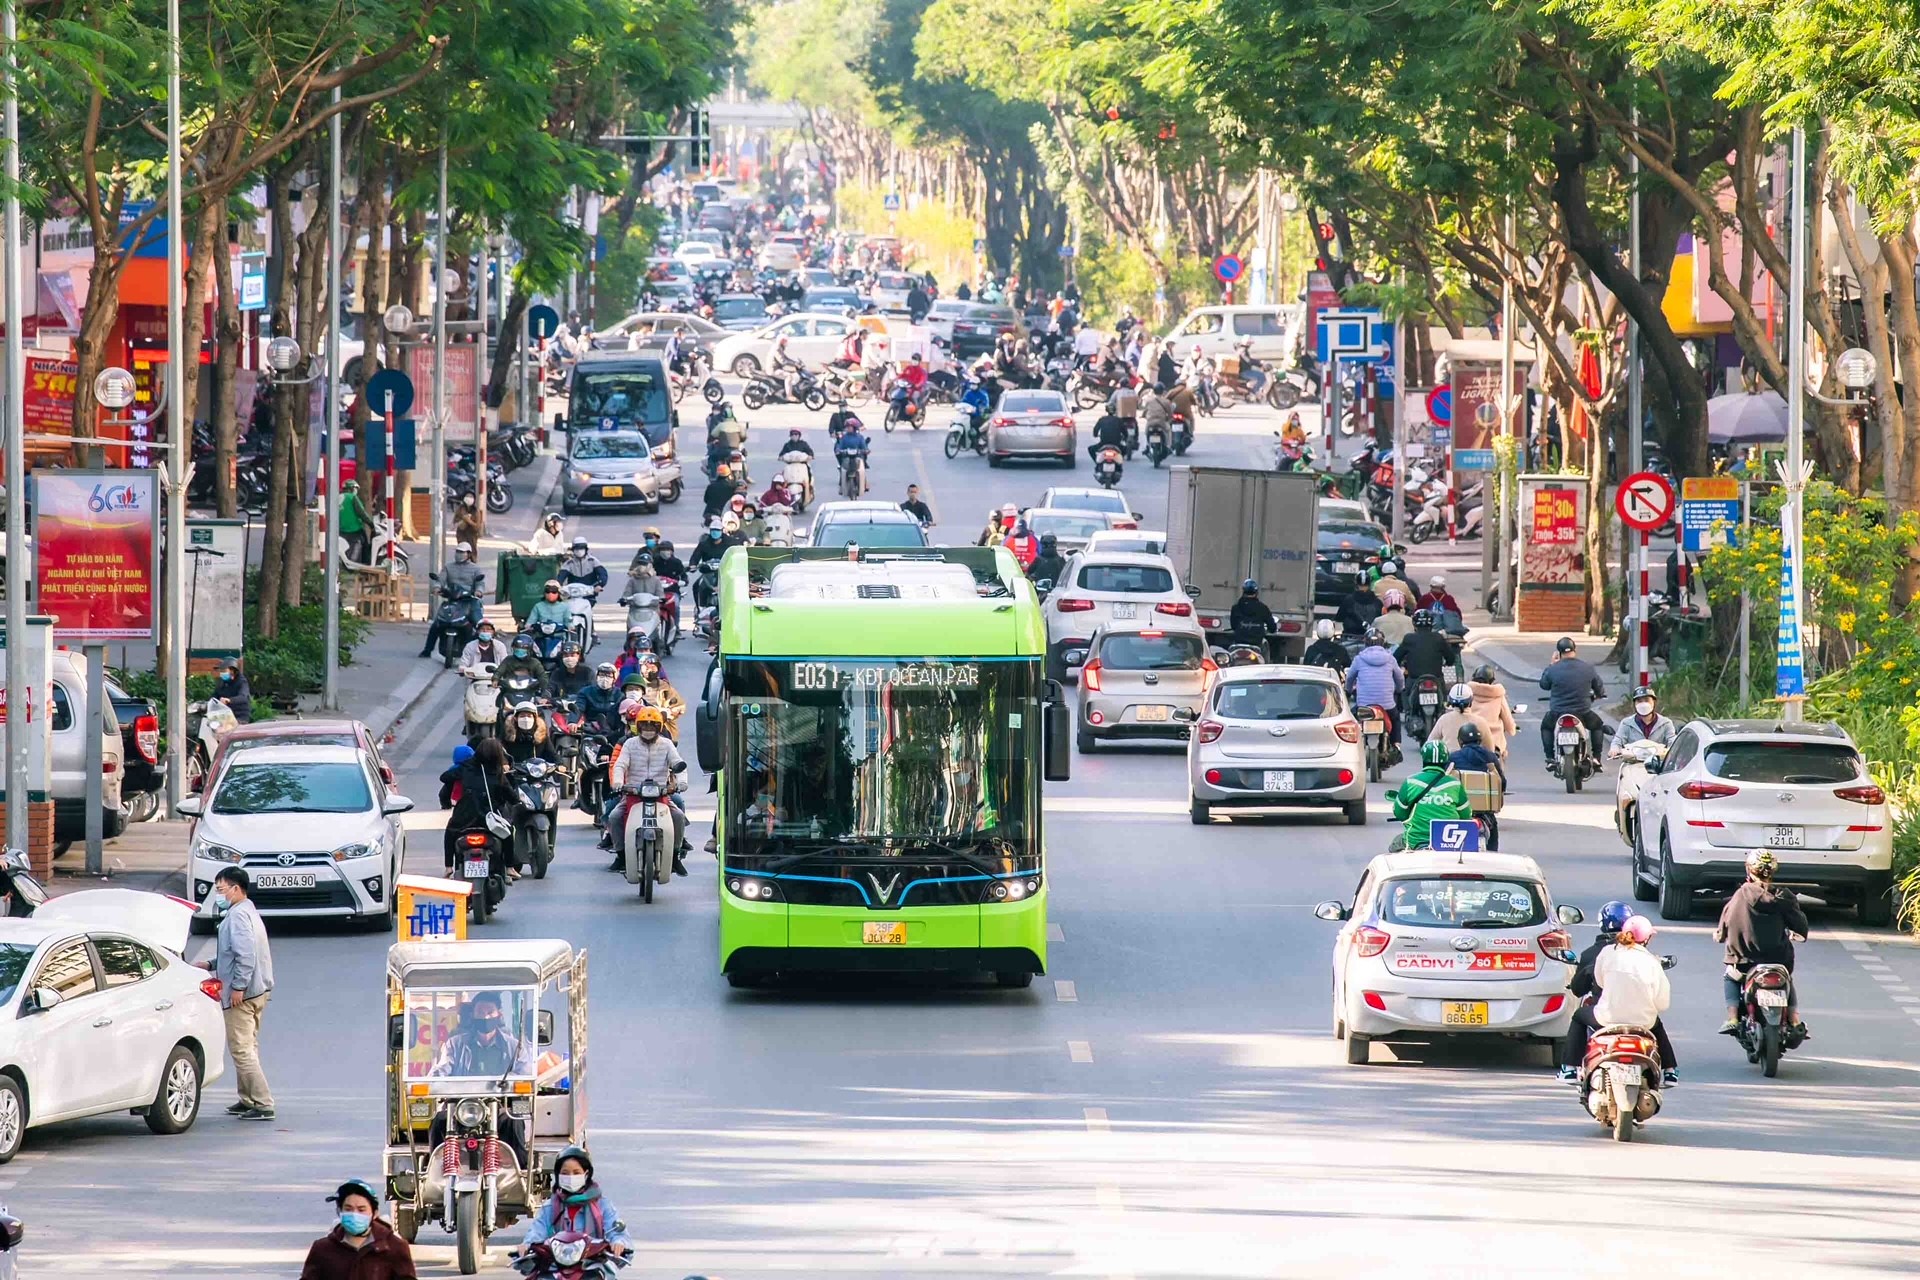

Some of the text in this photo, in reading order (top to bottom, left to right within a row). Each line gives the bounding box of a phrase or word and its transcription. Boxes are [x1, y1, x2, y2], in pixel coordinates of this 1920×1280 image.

[124, 568, 142, 578] NAM
[794, 663, 827, 688] E03
[1271, 772, 1287, 781] 30F
[1265, 781, 1293, 791] 374.33
[1441, 823, 1468, 848] G7
[1775, 827, 1793, 837] 30H
[1769, 836, 1800, 846] 121.04
[258, 875, 314, 887] 30A-284.90
[1492, 892, 1509, 901] 32
[875, 923, 894, 932] 29F
[1397, 959, 1454, 968] CADIVI
[1476, 955, 1491, 967] SỐ
[1493, 954, 1503, 969] 1
[1504, 960, 1518, 968] VIỆT
[1455, 1003, 1474, 1012] 30A
